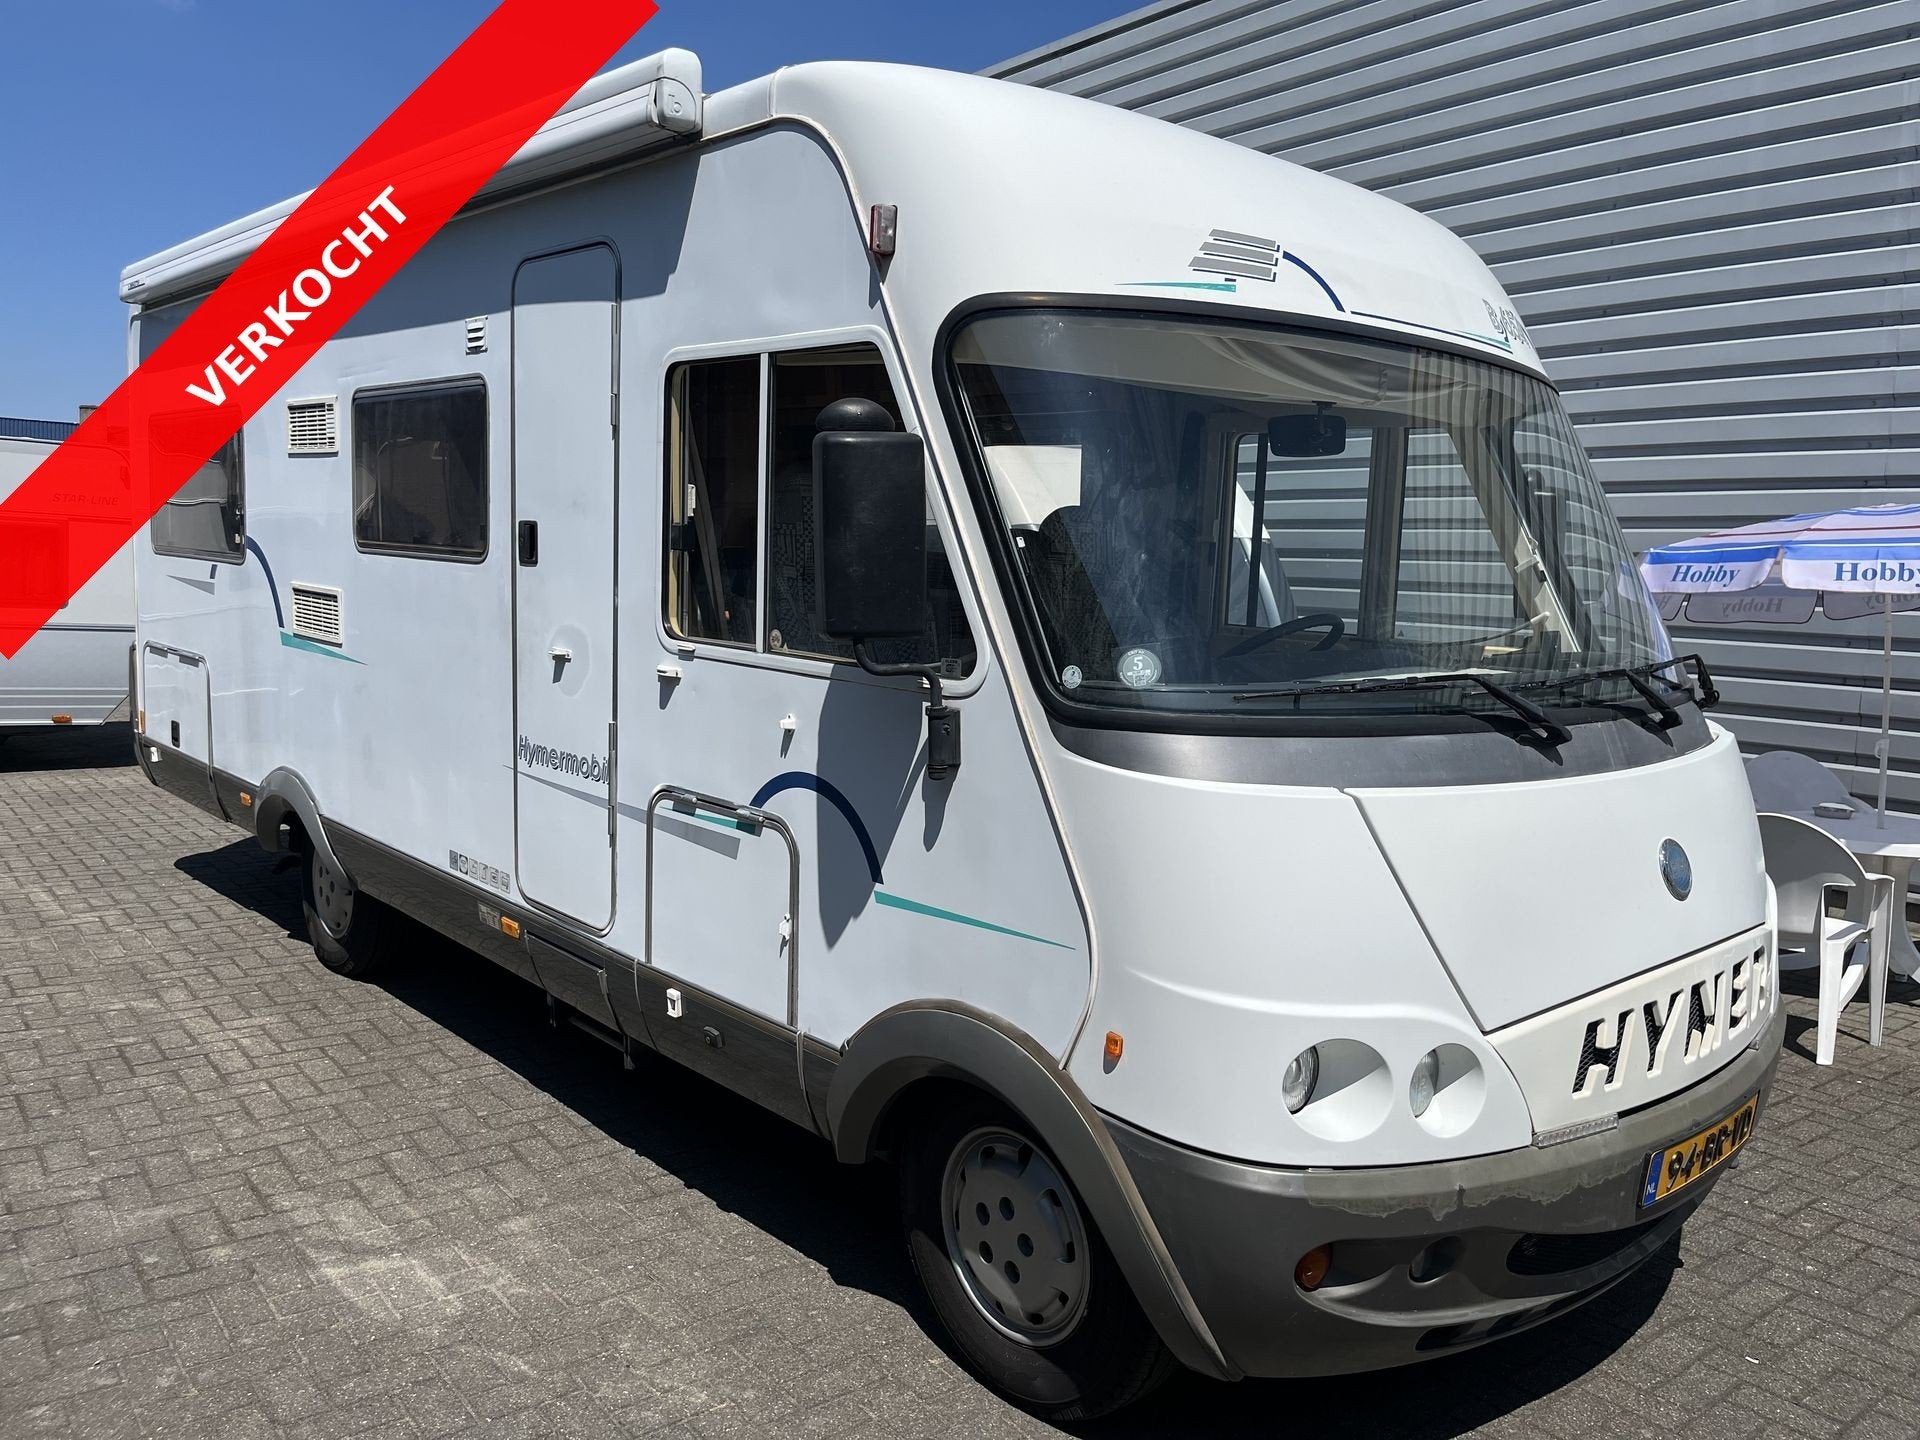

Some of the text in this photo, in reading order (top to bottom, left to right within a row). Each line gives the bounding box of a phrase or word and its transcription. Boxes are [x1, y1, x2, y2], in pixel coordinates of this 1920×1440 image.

[1671, 564, 1740, 588] Hobby
[1132, 656, 1143, 671] 5
[1571, 945, 1768, 1099] HYMER
[1646, 1184, 1656, 1196] NL
